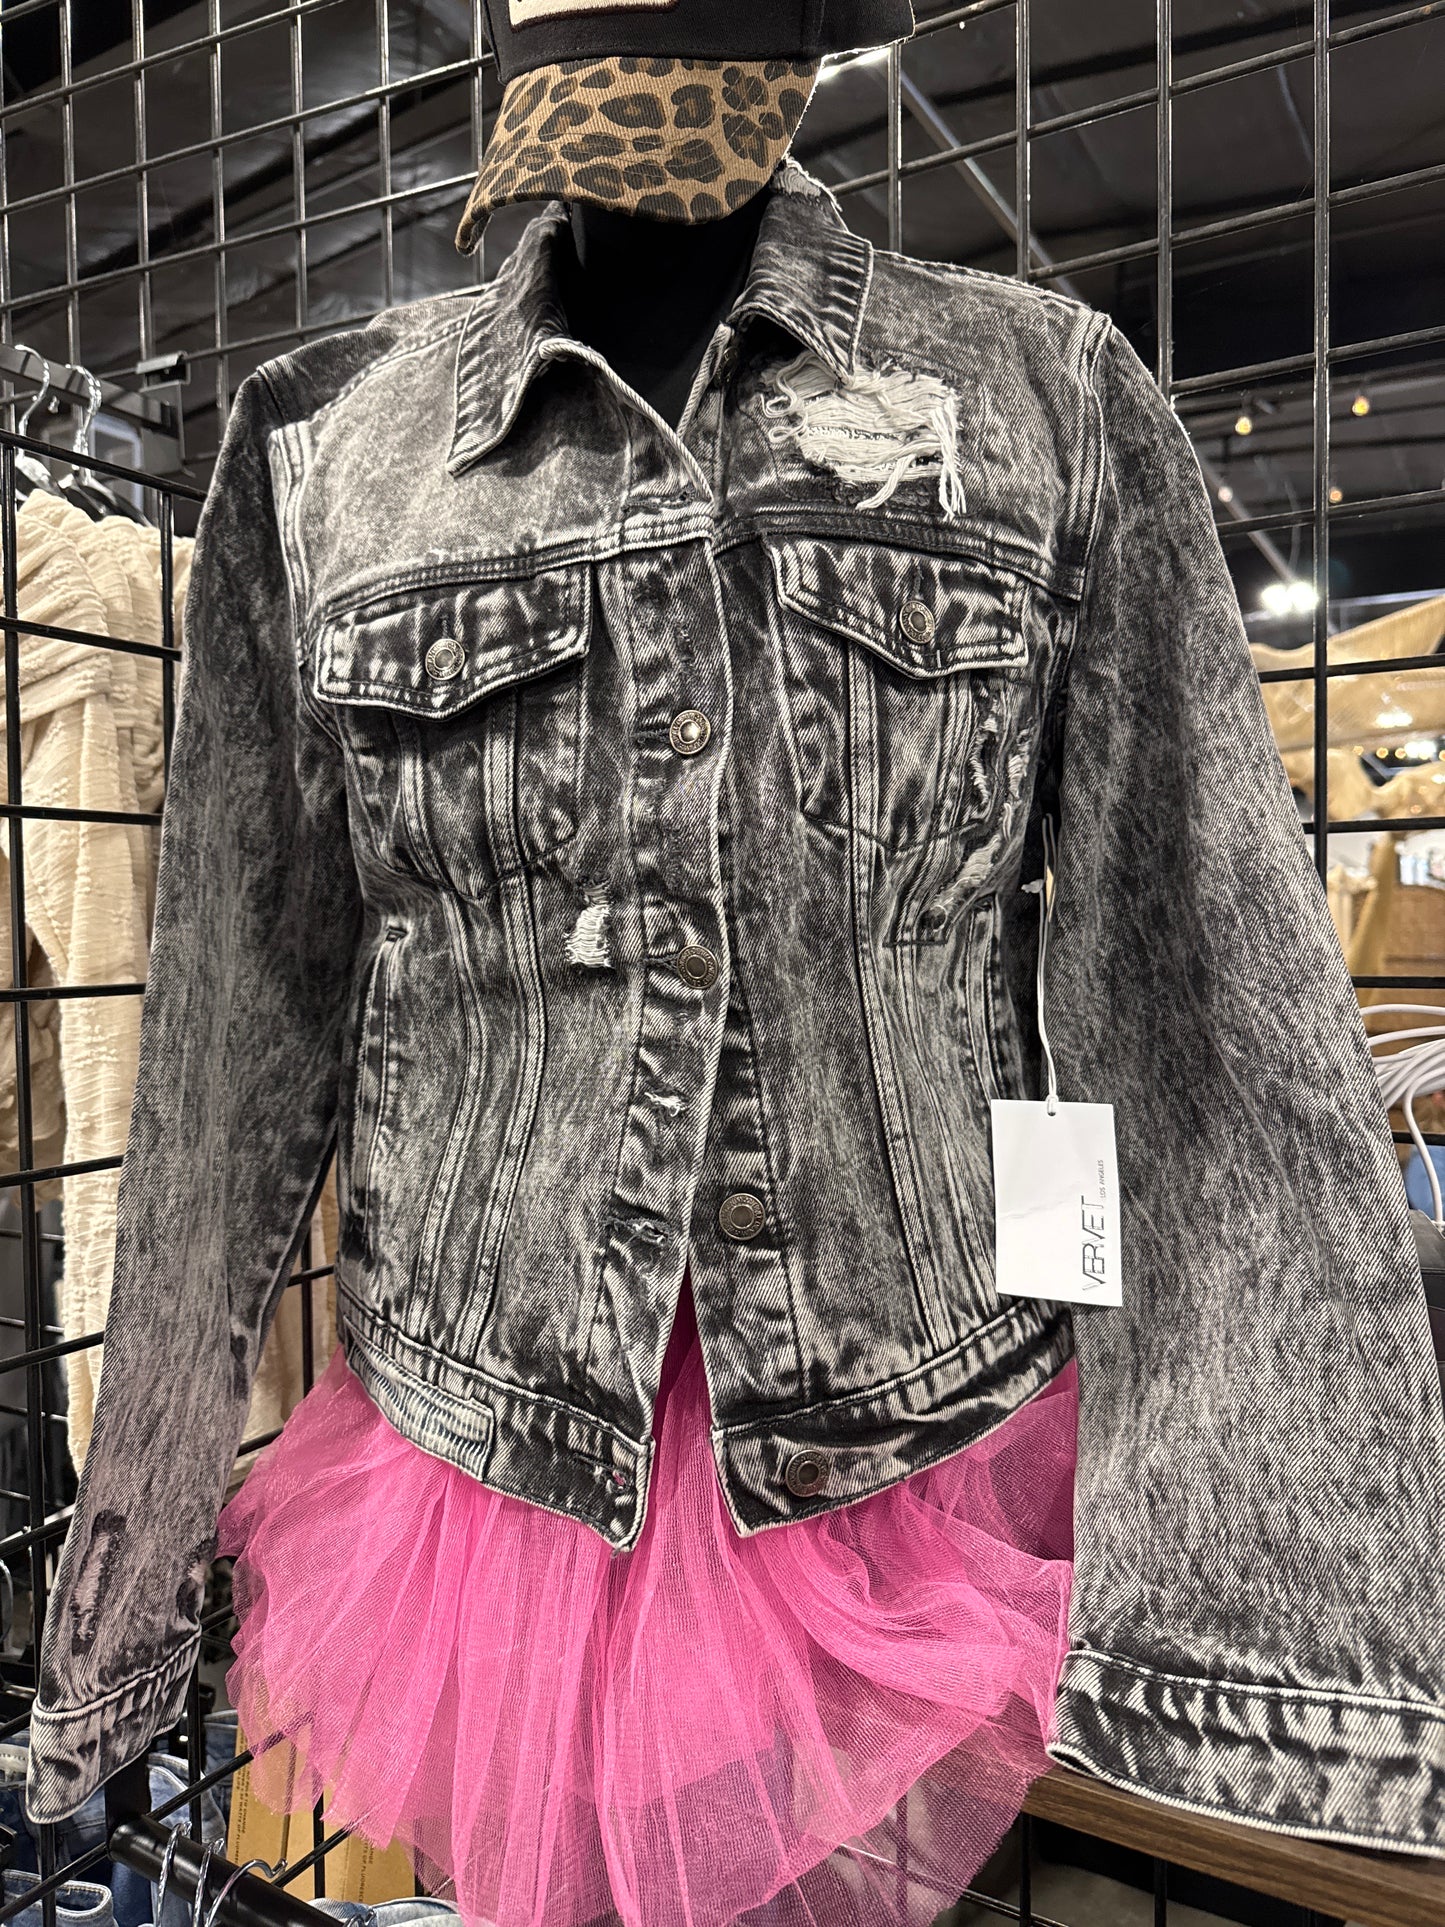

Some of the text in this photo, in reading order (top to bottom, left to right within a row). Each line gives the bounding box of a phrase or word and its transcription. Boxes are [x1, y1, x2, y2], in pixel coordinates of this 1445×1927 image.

[1097, 1159, 1105, 1186] ANGELES
[1081, 1195, 1106, 1291] VERVET
[358, 1865, 367, 1903] FLUORESCE
